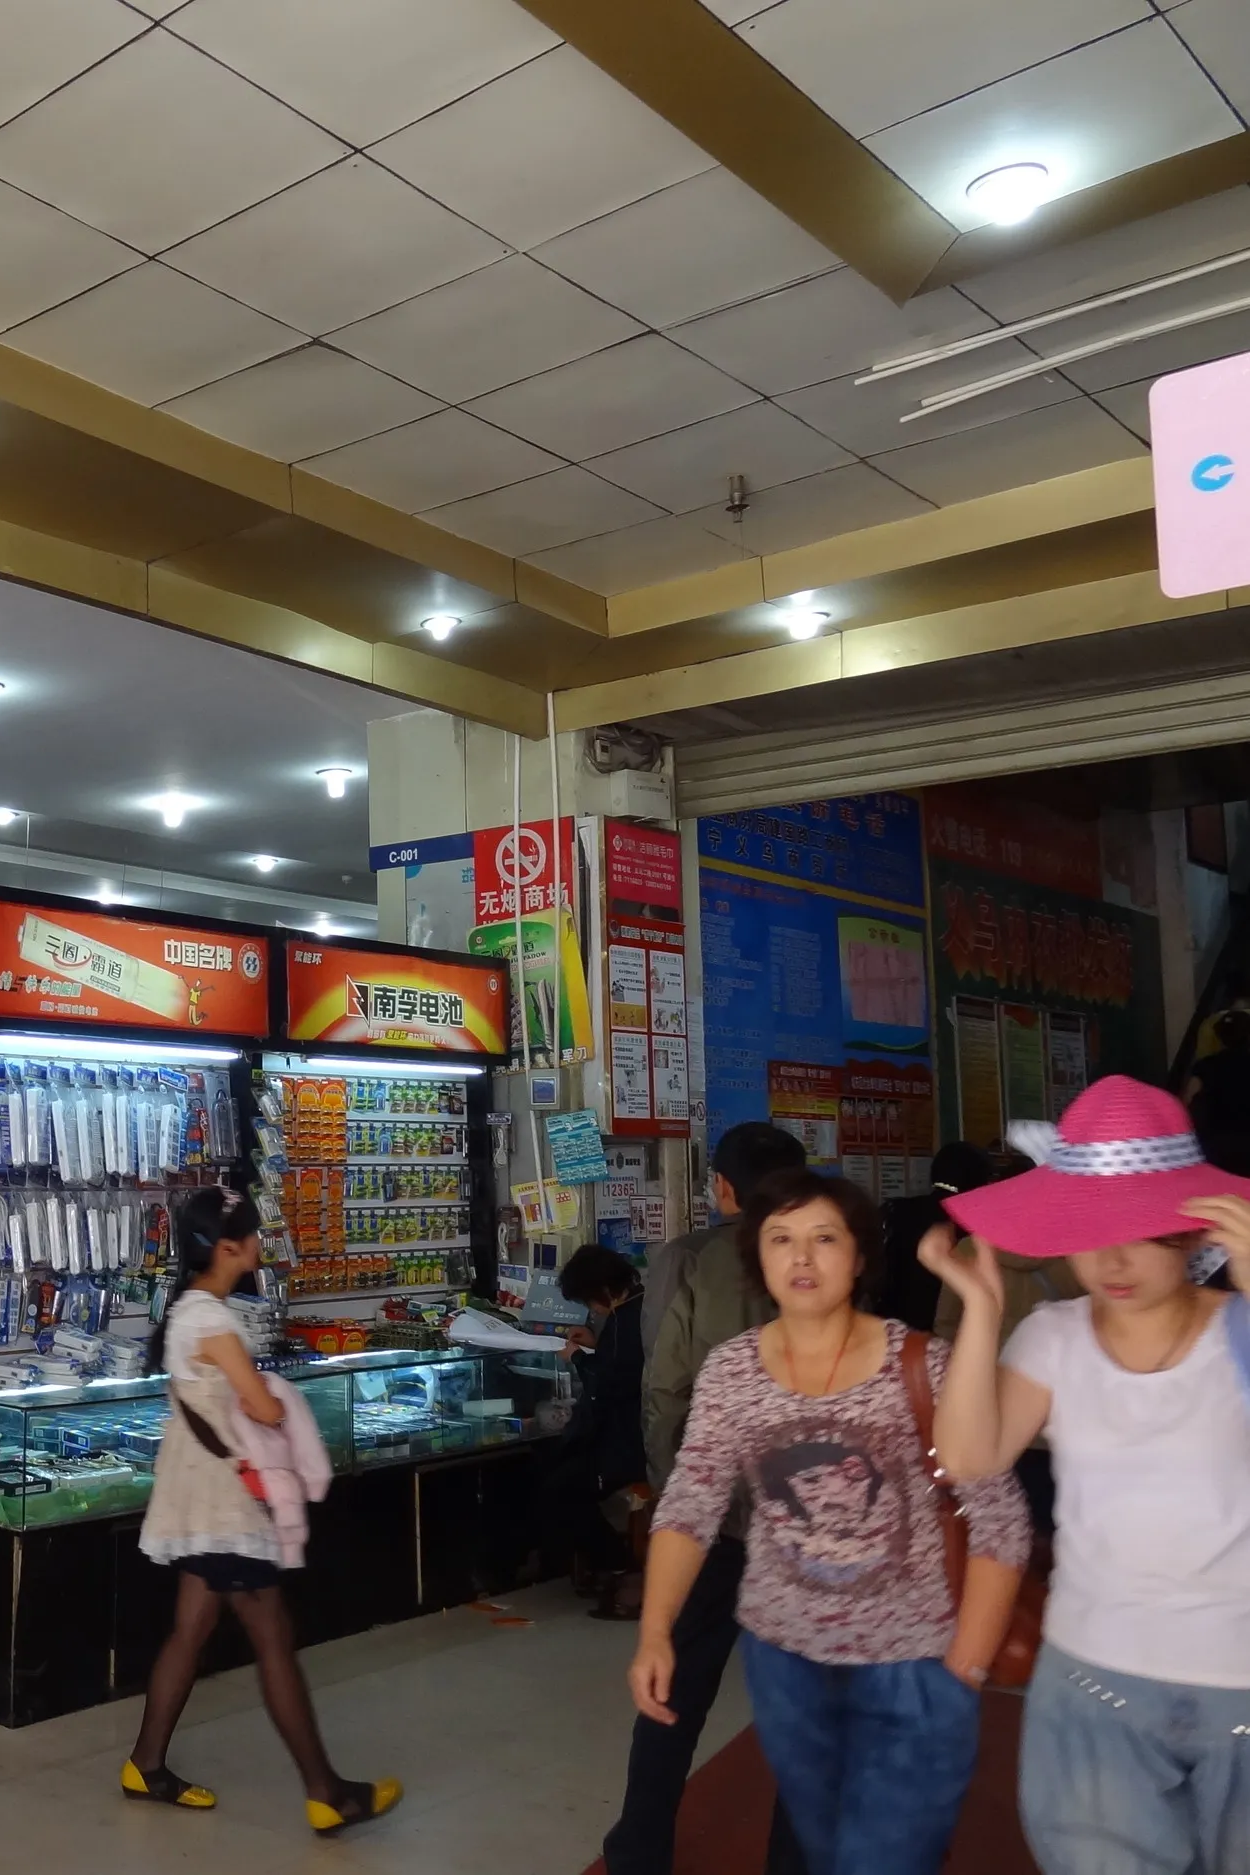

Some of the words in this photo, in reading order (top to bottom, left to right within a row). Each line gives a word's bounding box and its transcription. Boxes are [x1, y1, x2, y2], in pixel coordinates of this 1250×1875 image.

[389, 848, 419, 864] C-001
[479, 882, 570, 916] 无烟商场
[163, 938, 233, 972] 中国名牌
[372, 983, 464, 1027] 南孚电池
[605, 1182, 635, 1197] 12365
